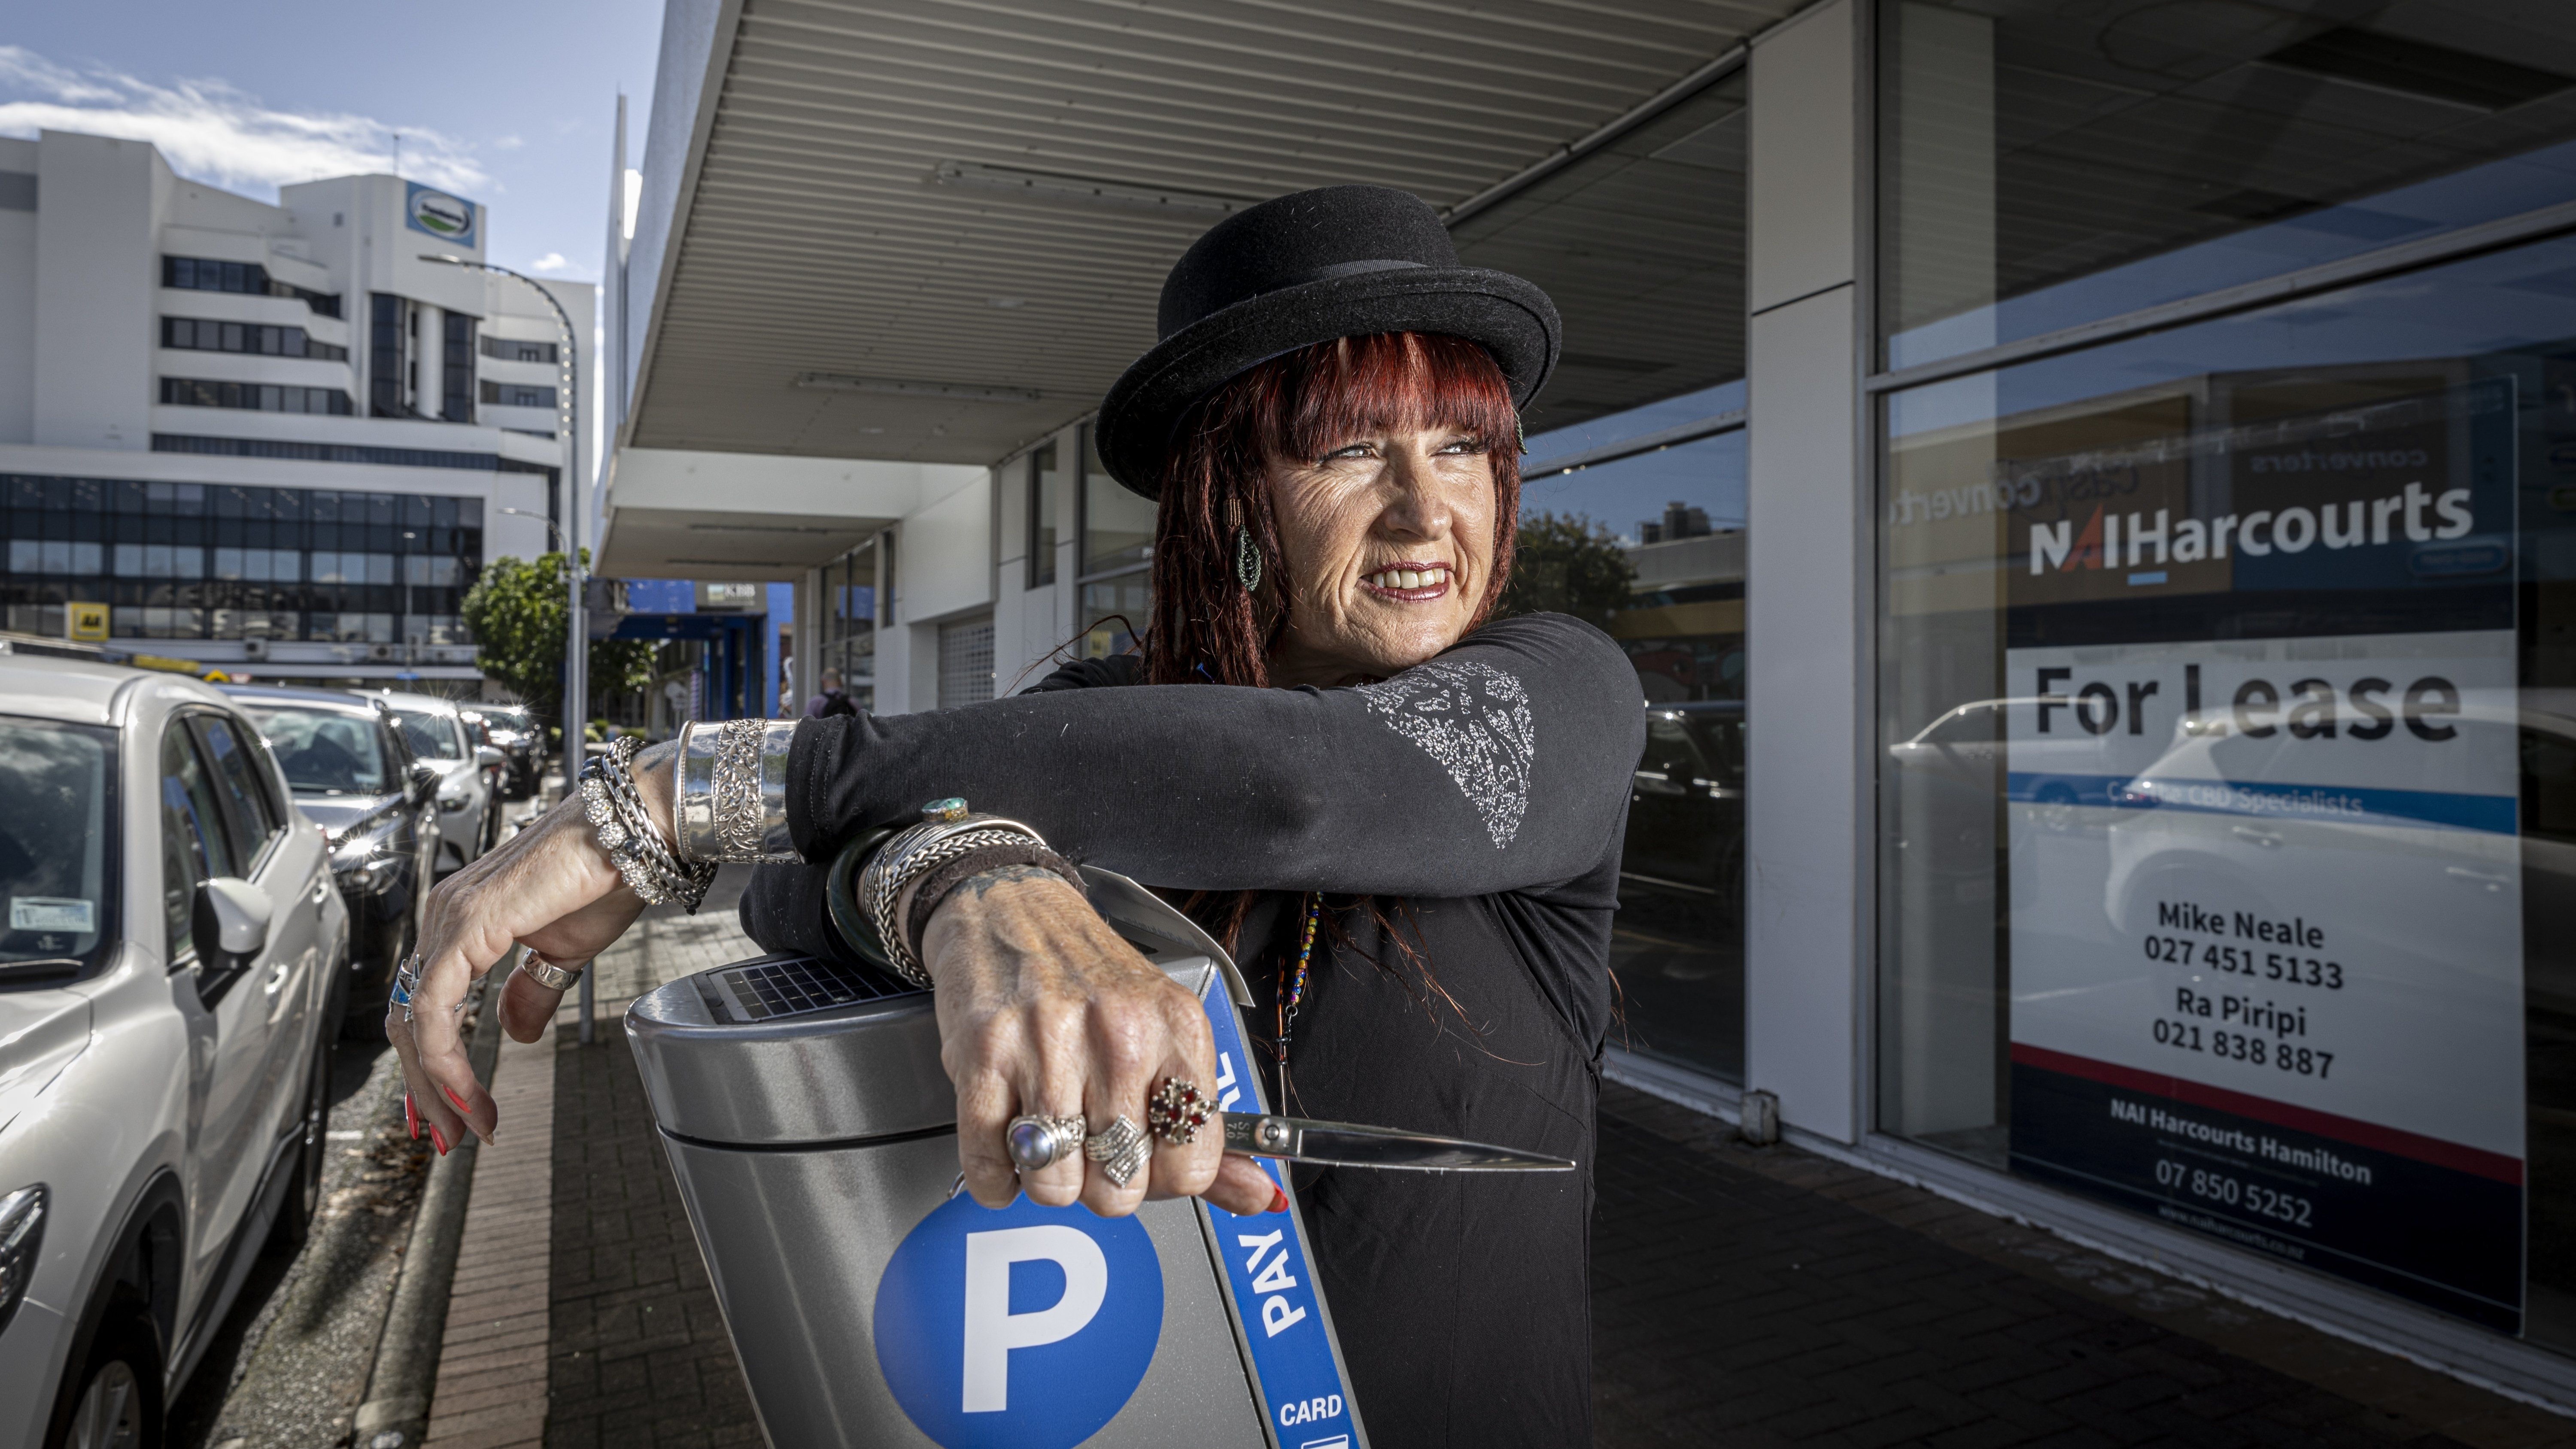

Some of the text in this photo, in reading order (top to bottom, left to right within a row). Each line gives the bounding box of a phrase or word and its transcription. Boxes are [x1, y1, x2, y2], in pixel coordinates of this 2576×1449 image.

[2037, 664, 2461, 742] For Lease
[2188, 786, 2232, 808] CBD
[2238, 788, 2364, 816] Specialists
[2158, 901, 2324, 950] Mike Neale
[2145, 935, 2343, 990] 027 451 5133
[2177, 987, 2306, 1039] Ra Piripi
[2153, 1018, 2334, 1079] 021 838 887
[2110, 1098, 2145, 1124] NAI
[2150, 1107, 2255, 1154] Harcourts
[2260, 1136, 2372, 1185] Hamilton
[2156, 1159, 2187, 1188] 07
[2191, 1169, 2240, 1204] 850
[2245, 1184, 2312, 1228] 5252
[1237, 1229, 1306, 1338] PAY
[963, 1225, 1108, 1413] P
[1280, 1394, 1342, 1427] CARD
